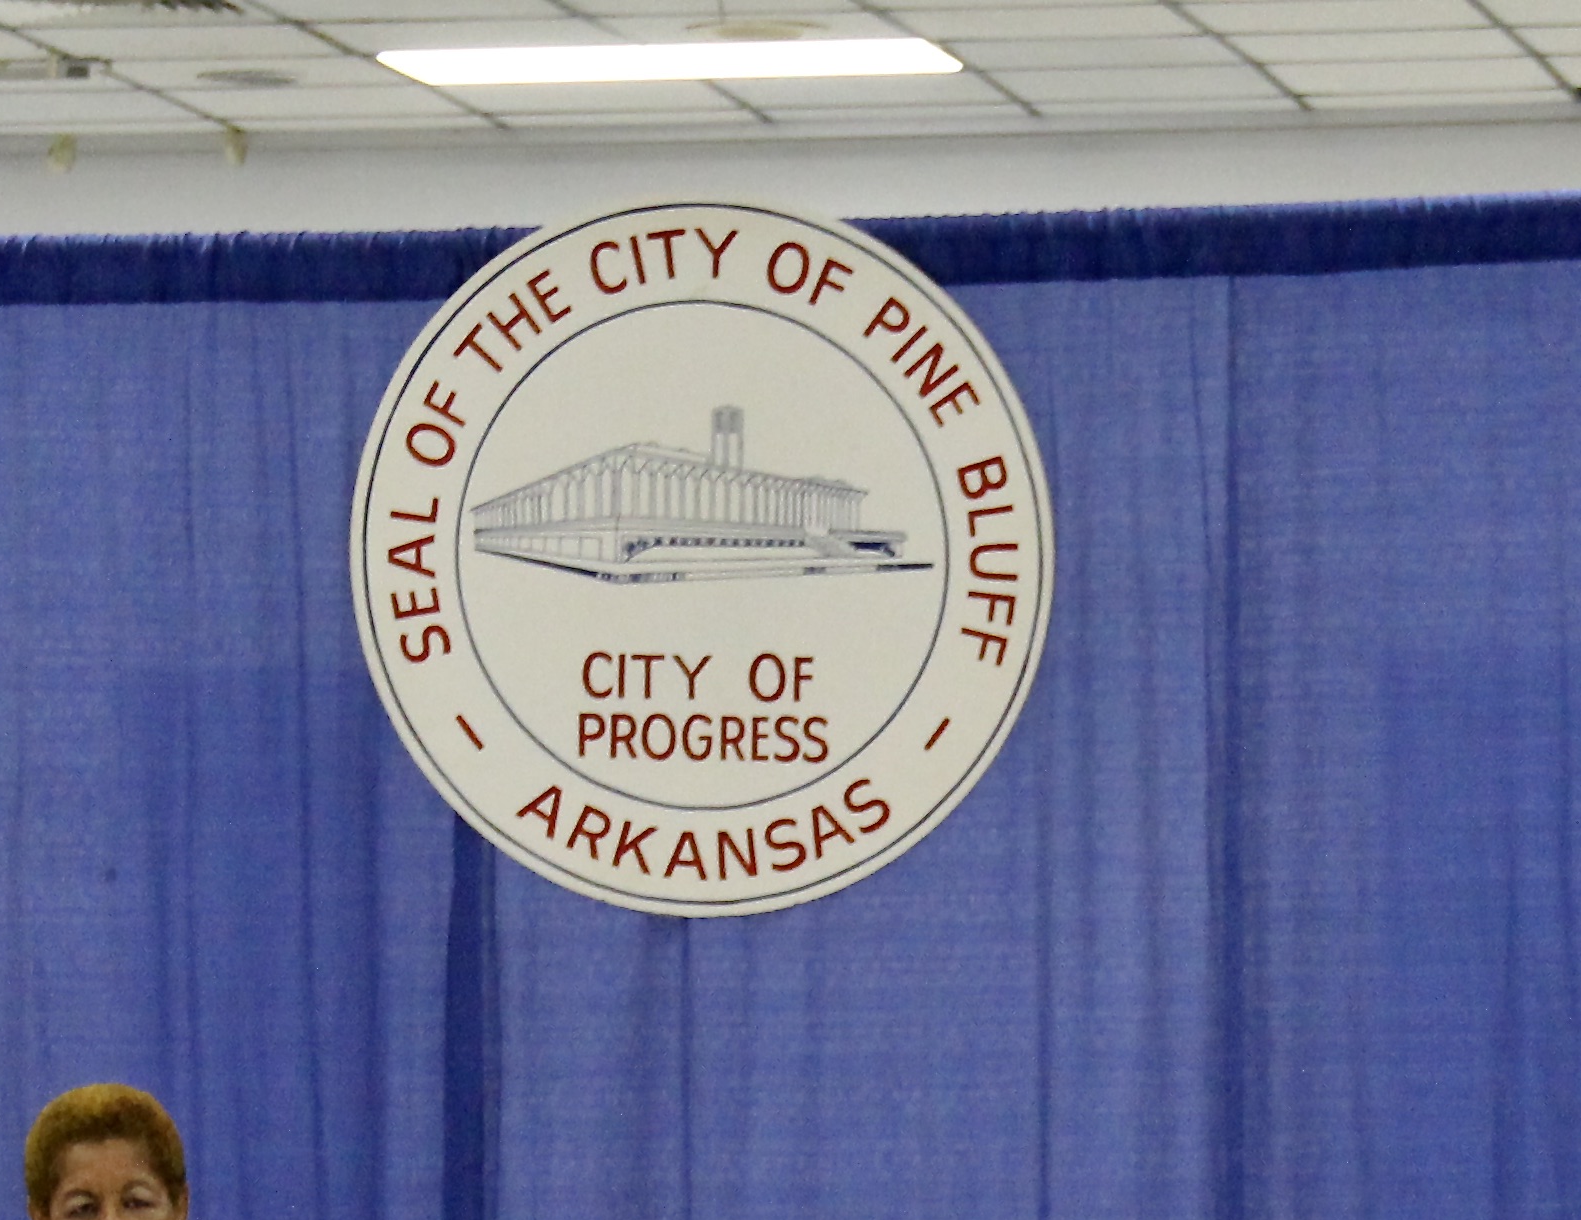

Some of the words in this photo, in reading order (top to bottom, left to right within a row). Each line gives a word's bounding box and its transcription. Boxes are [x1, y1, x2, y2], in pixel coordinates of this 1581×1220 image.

[589, 228, 739, 295] CITY
[766, 241, 853, 306] OF
[453, 270, 572, 373] THE
[863, 297, 980, 427] PINE
[406, 381, 466, 467] OF
[387, 497, 452, 664] SEAL
[957, 454, 1019, 667] BLUFF
[581, 651, 713, 700] CITY
[748, 653, 815, 703] OF
[577, 712, 830, 764] PROGRESS
[516, 778, 892, 881] ARKANSAS
